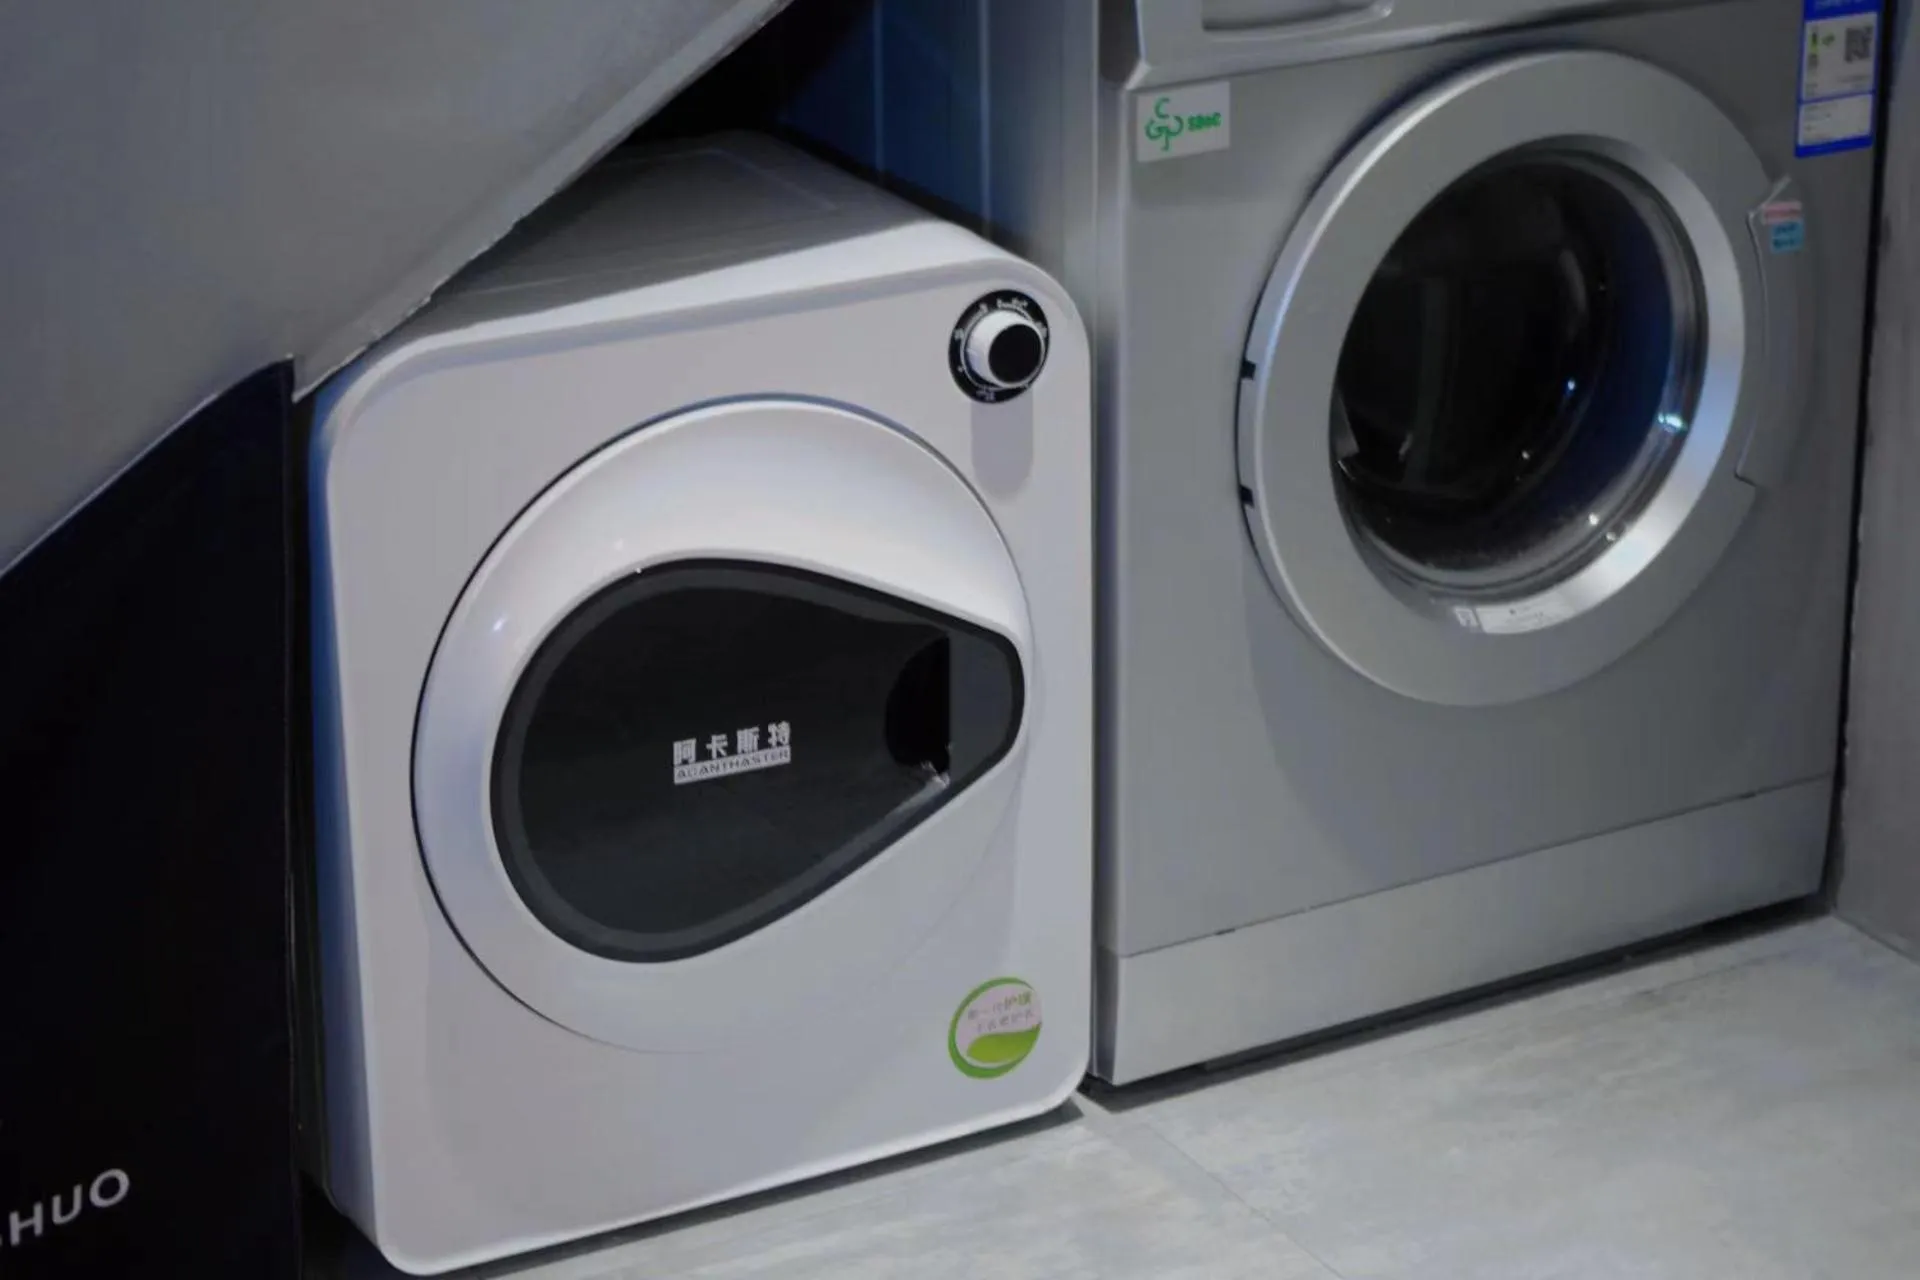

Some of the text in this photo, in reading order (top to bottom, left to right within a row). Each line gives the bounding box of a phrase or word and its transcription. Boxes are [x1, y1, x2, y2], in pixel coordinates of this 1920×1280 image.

[673, 720, 790, 766] 阿卡斯特
[0, 1168, 130, 1248] HUO
